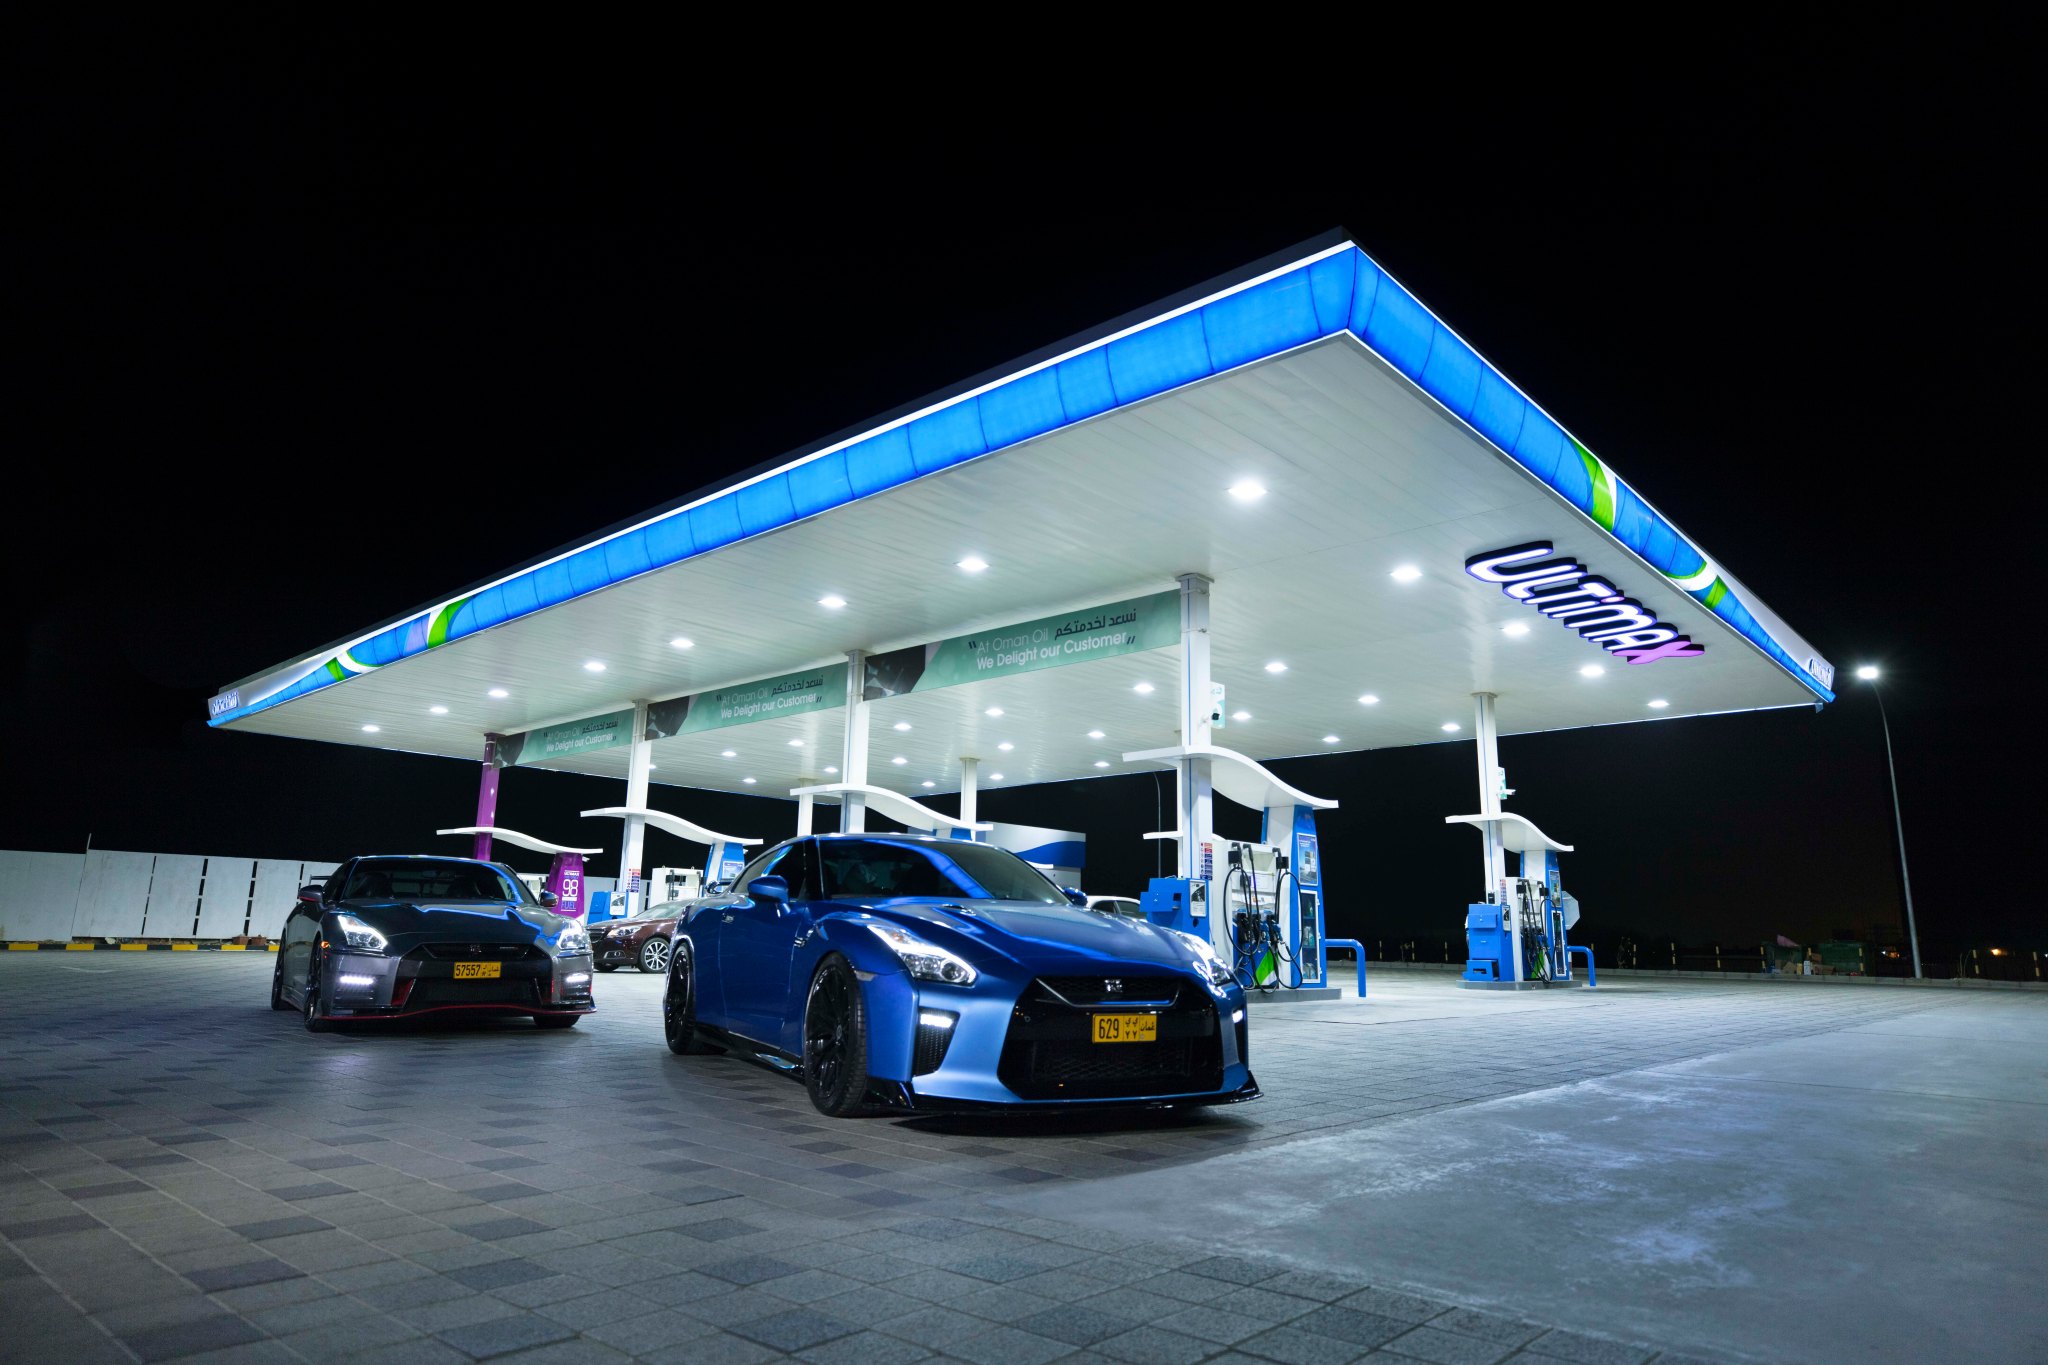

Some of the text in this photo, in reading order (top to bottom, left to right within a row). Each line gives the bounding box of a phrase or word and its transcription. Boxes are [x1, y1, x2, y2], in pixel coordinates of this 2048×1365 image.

[1055, 609, 1137, 640] نسعد لخدمتكم
[992, 635, 1029, 651] Oman
[1032, 628, 1048, 643] Oil
[977, 657, 993, 670] We
[997, 647, 1037, 666] Delight
[1040, 645, 1060, 658] our
[771, 675, 824, 697] نسعد لخدمتكم
[732, 692, 756, 704] Oman
[757, 688, 768, 698] Oil
[721, 708, 732, 719] We
[733, 702, 760, 717] Delight
[762, 701, 775, 712] our
[546, 743, 554, 752] We
[555, 739, 574, 751] Delight
[574, 738, 584, 747] our
[562, 879, 579, 897] 98
[561, 901, 576, 910] FUEL
[455, 964, 480, 977] 57557
[1099, 1018, 1119, 1039] 629
